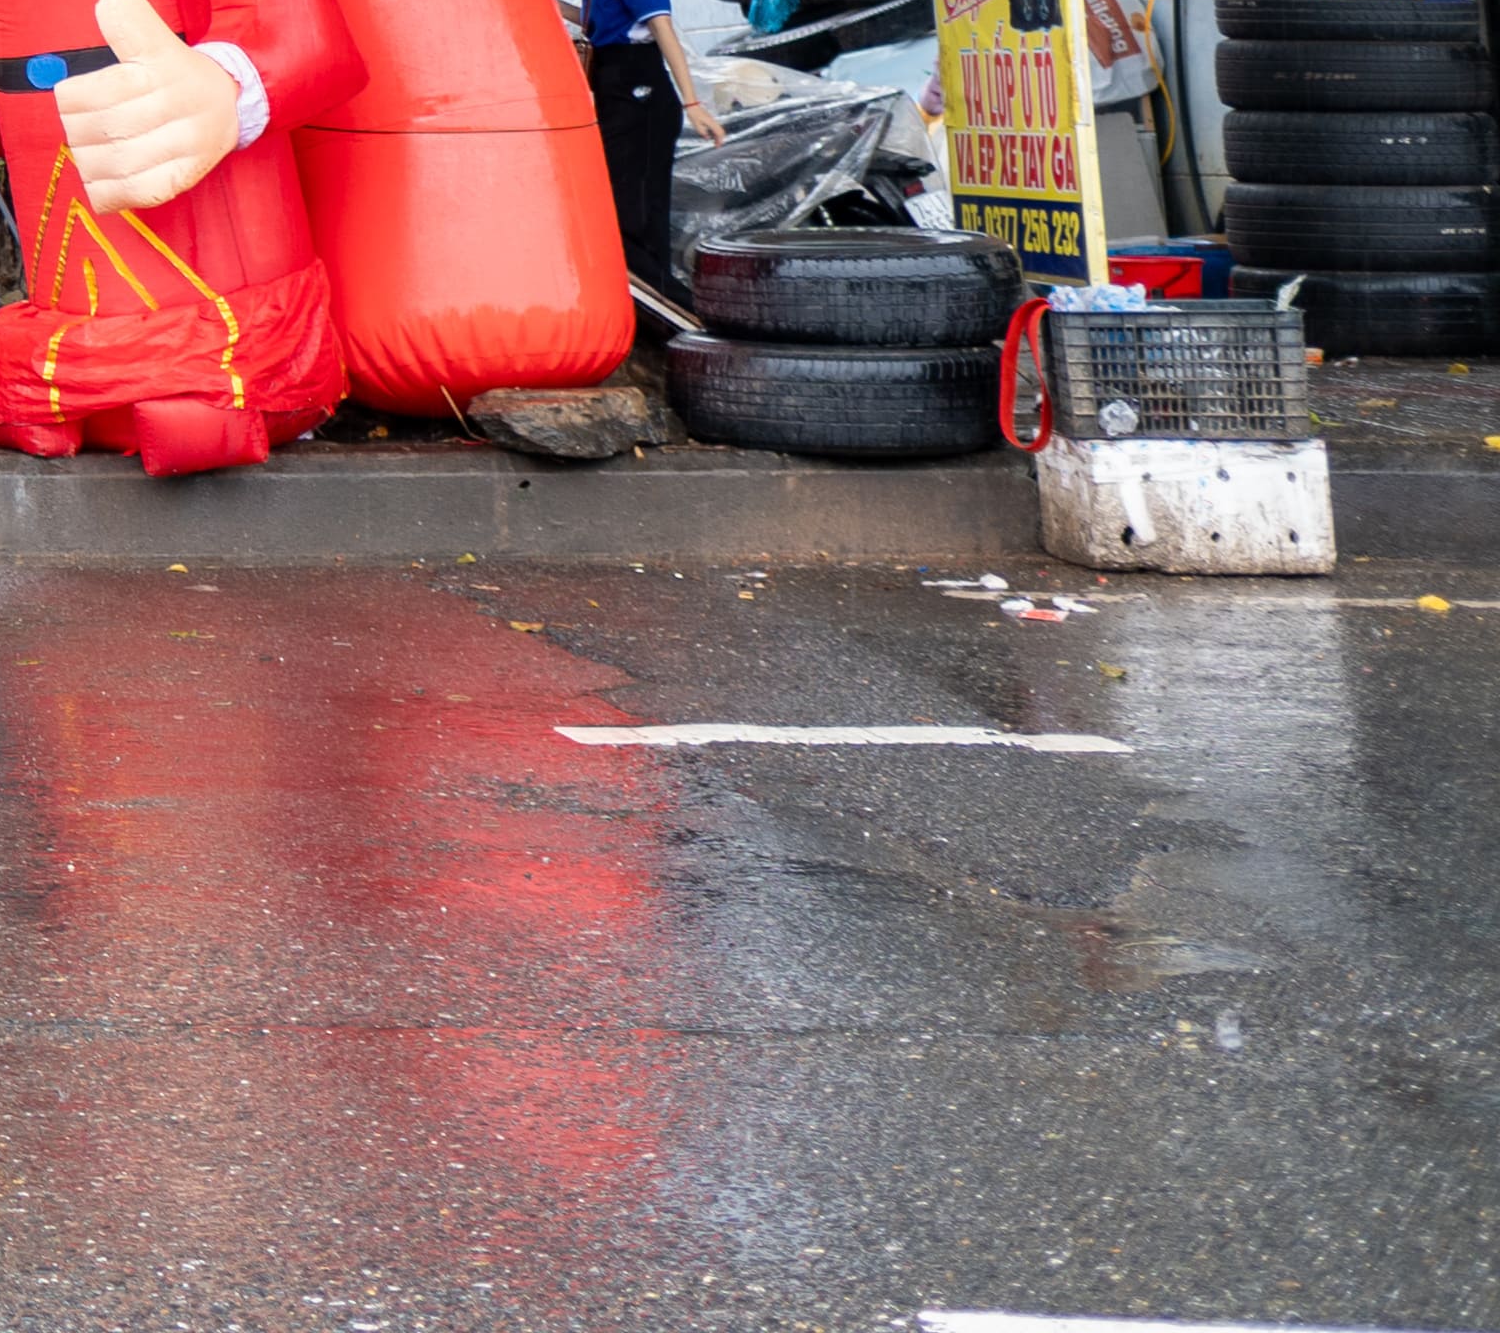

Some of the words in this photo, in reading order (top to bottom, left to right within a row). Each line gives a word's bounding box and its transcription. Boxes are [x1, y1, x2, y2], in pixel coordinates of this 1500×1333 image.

[998, 134, 1018, 188] XE
[1021, 135, 1046, 190] TAY
[1052, 135, 1077, 193] GA
[1023, 207, 1050, 253] 256
[1052, 210, 1081, 257] 232
